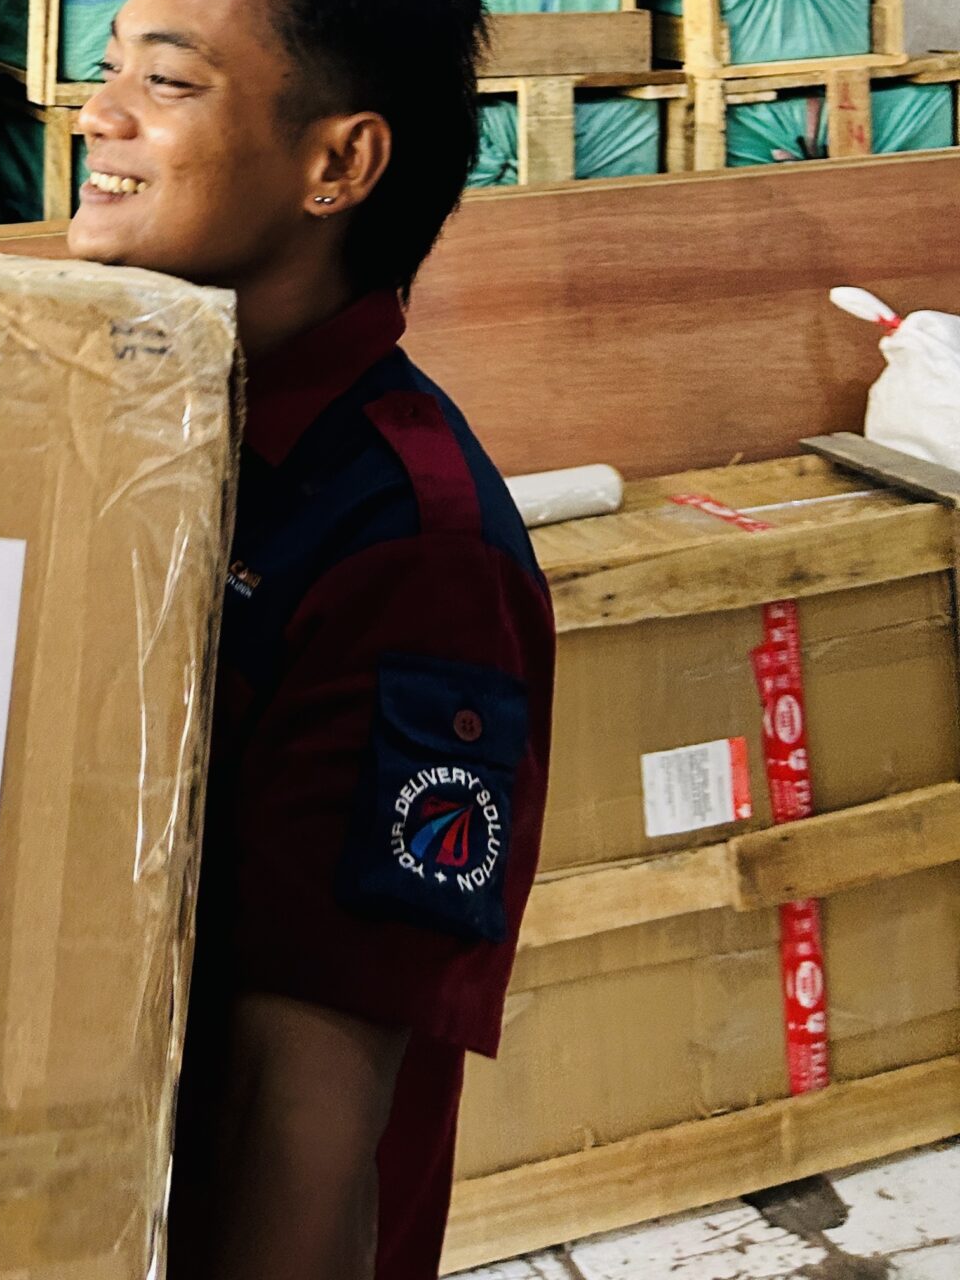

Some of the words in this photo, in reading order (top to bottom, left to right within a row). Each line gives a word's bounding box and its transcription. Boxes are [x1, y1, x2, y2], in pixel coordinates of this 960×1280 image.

[394, 766, 481, 818] DELIVERY
[390, 821, 426, 879] YOUR
[456, 788, 502, 893] SOLUTION
